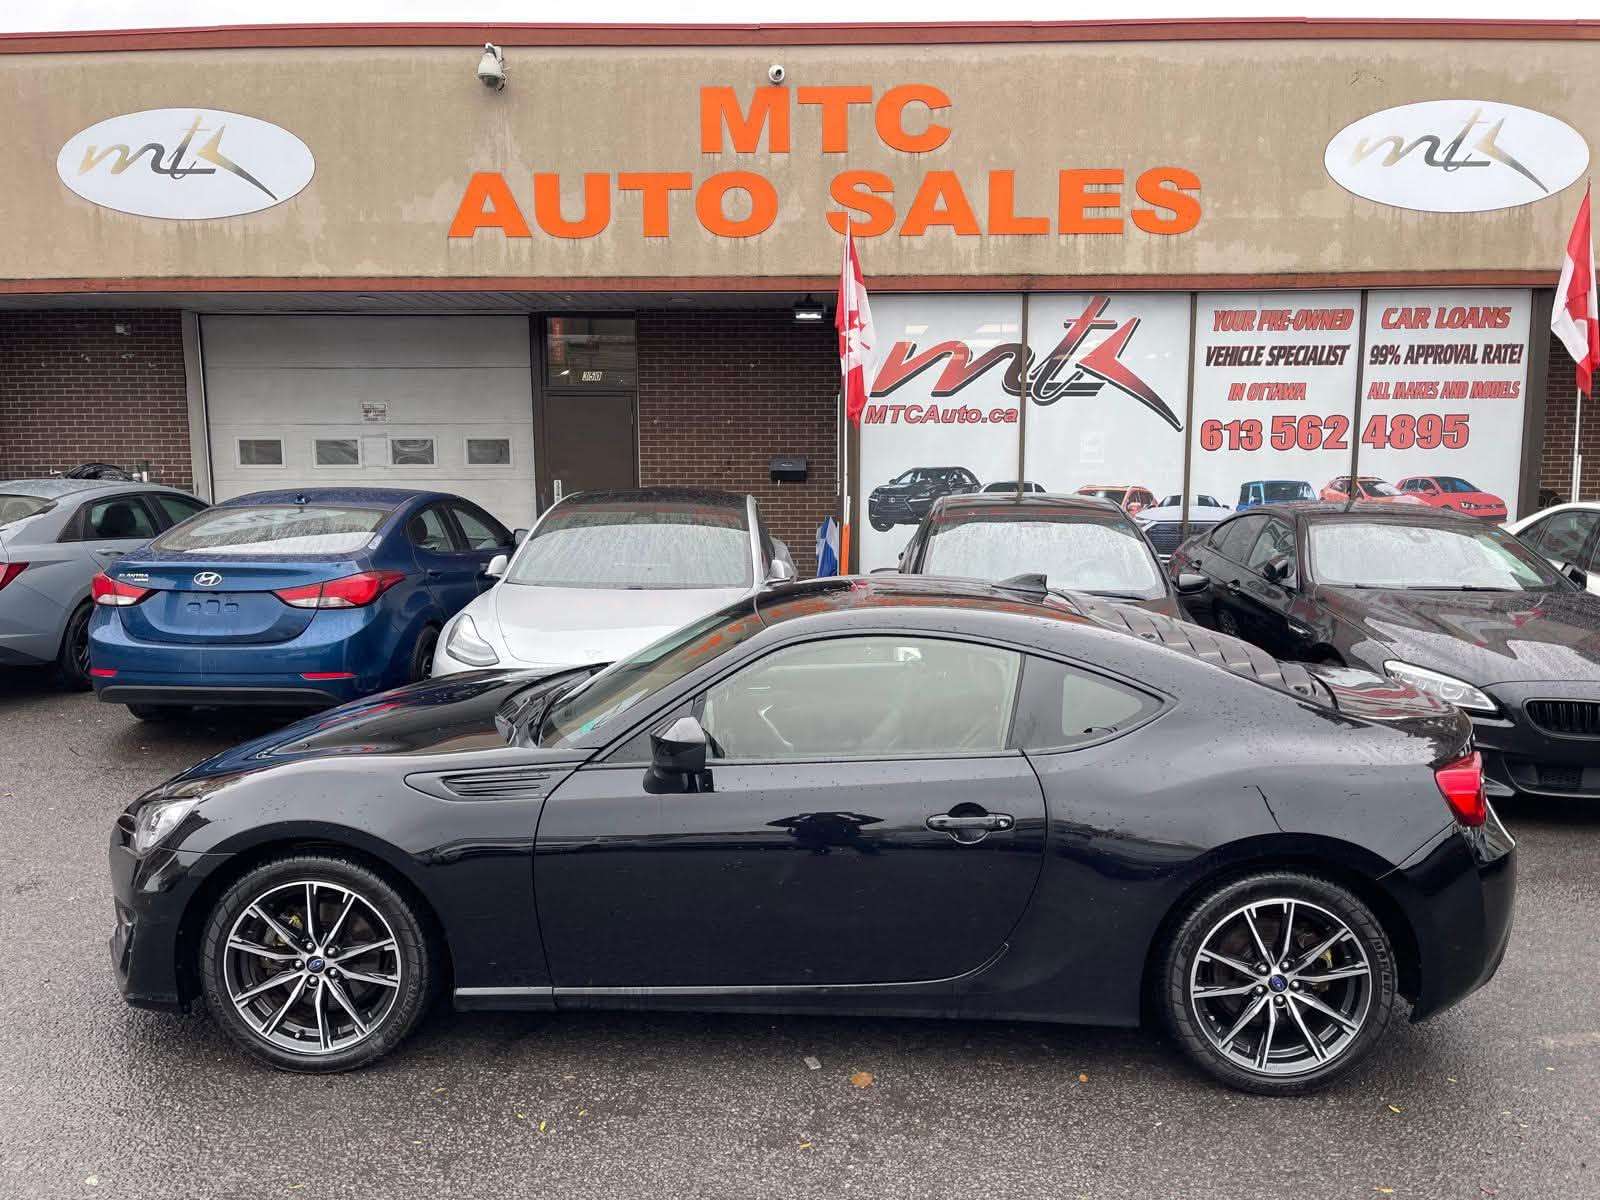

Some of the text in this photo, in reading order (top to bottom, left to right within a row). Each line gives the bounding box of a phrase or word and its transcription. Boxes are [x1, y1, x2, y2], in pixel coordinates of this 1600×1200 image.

[700, 84, 952, 154] MTC
[448, 167, 1202, 239] AUTO SALES
[1213, 309, 1354, 332] YOUR PRE-OWNED
[1381, 306, 1512, 329] CAR LOANS
[1205, 344, 1351, 367] VEHICLE SPECIALIST
[1369, 343, 1524, 365] 99% APPROVAL RATE!
[1228, 382, 1307, 401] IN OTTAWA
[1367, 381, 1521, 400] ALL MAKES AND MODELS
[864, 404, 1019, 424] MTCAuto.ca
[1200, 413, 1470, 451] 613 562 4895
